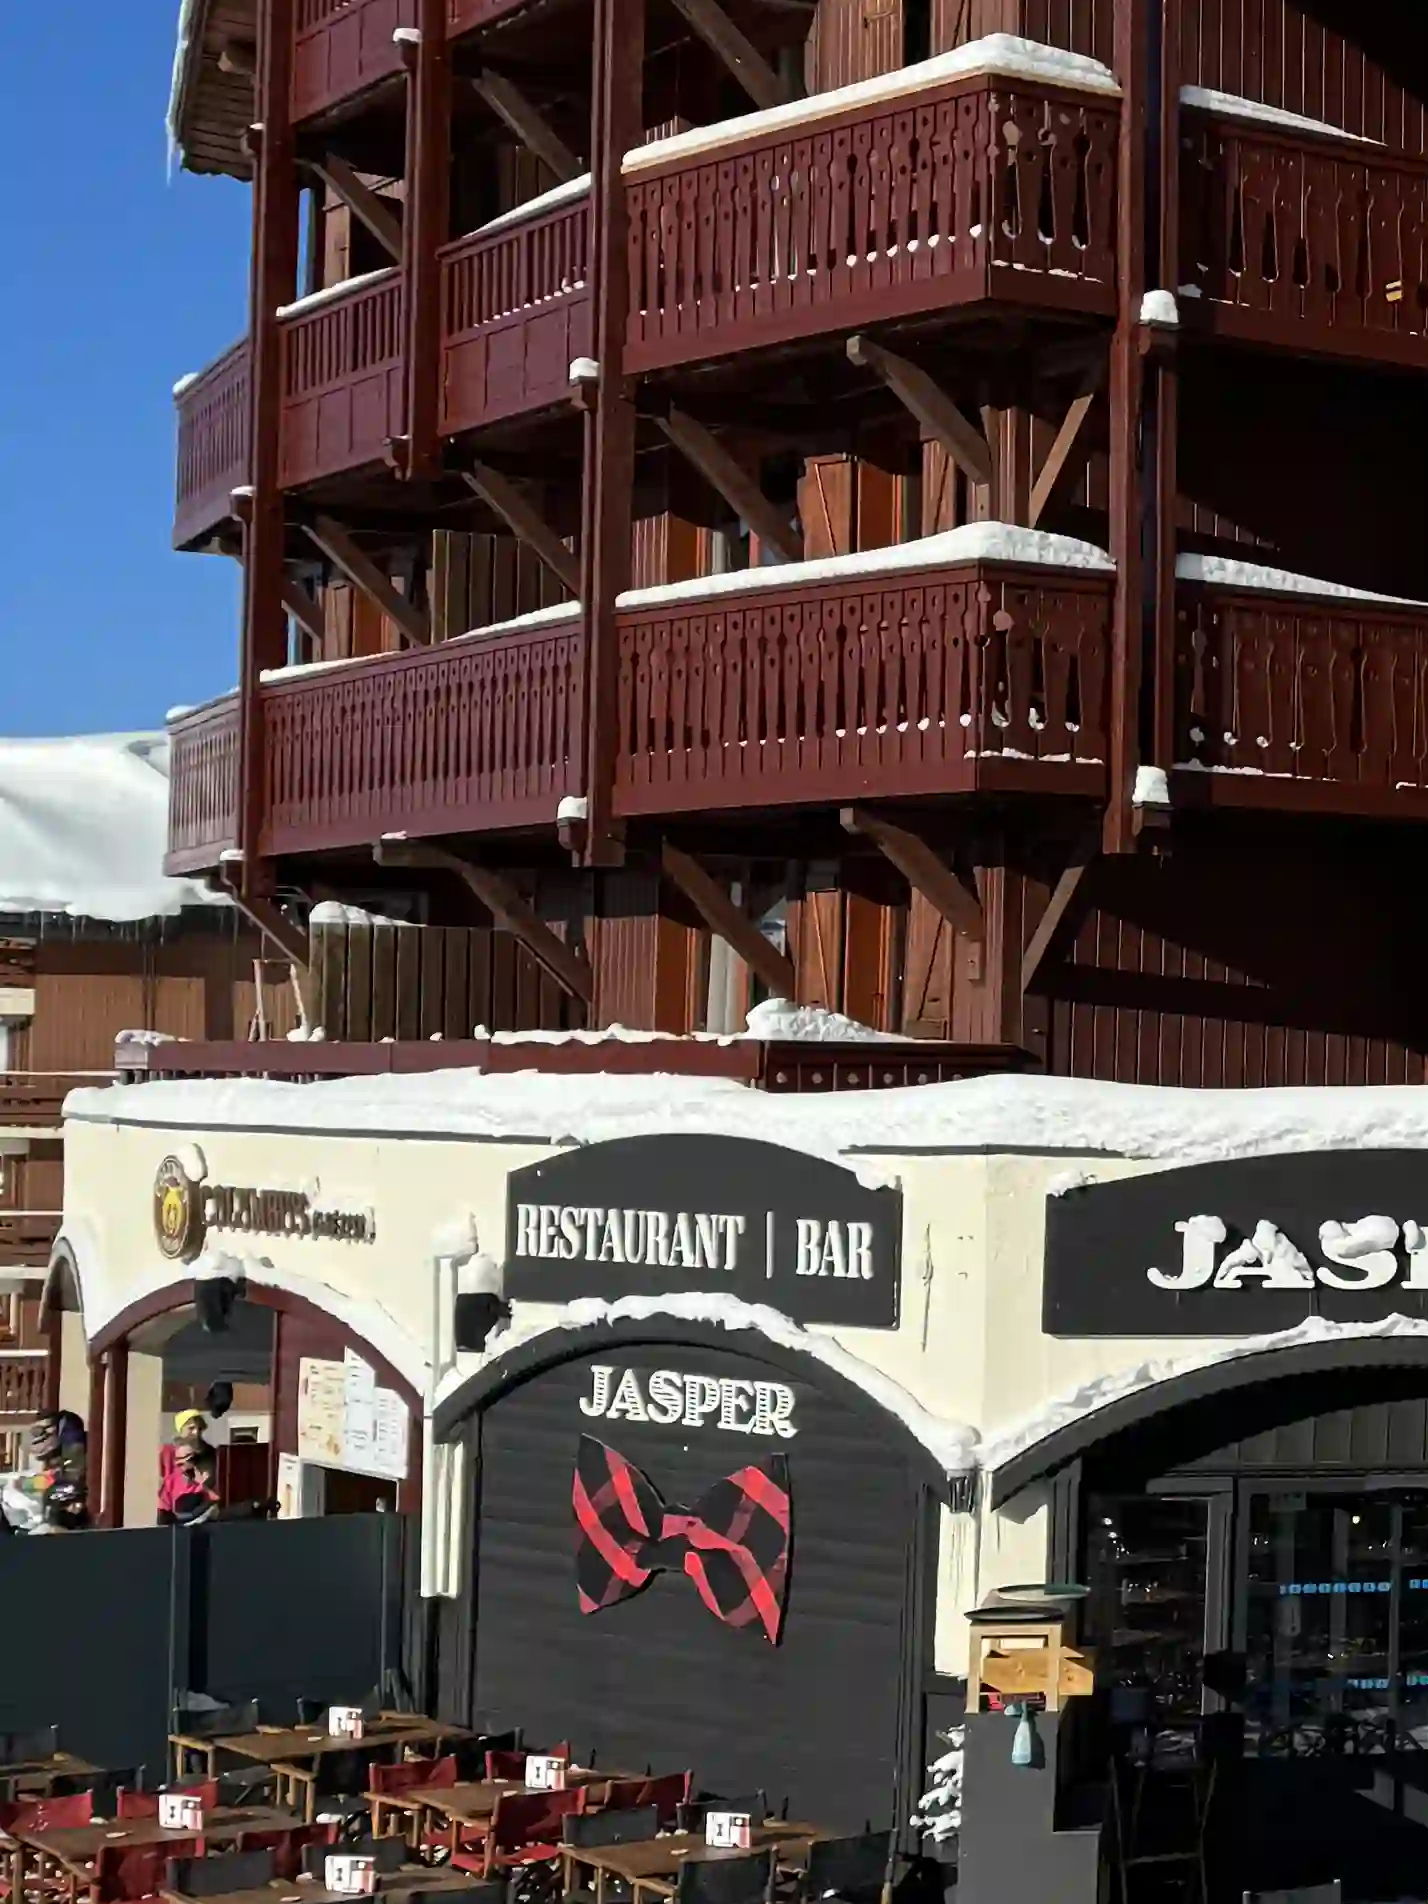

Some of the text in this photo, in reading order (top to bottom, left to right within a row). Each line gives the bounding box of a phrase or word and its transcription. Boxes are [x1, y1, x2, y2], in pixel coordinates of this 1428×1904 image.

[515, 1203, 745, 1271] RESTAURANT
[796, 1218, 874, 1280] BAR
[579, 1364, 799, 1438] JASPER
